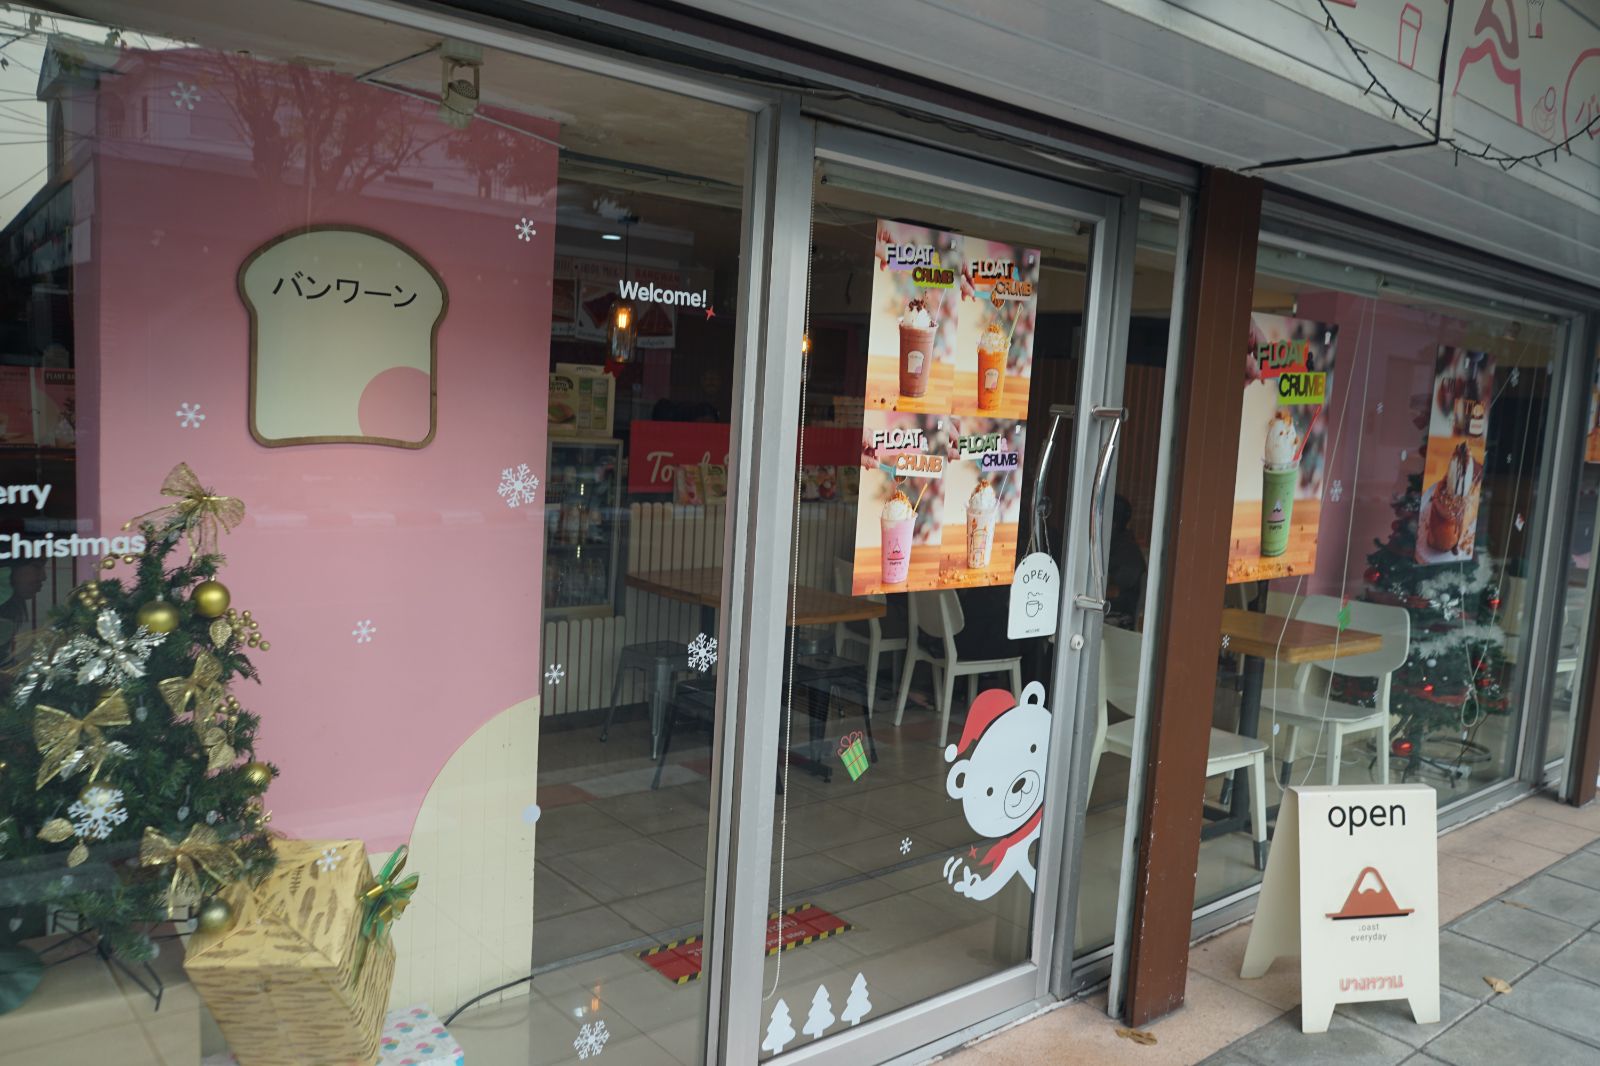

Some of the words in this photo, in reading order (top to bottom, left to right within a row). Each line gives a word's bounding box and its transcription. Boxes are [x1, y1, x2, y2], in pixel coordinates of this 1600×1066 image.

[885, 242, 934, 265] FLOAT
[912, 267, 954, 284] CRUMB
[969, 258, 1014, 279] FLOAT
[272, 270, 418, 309] バンワーン
[619, 279, 708, 308] Welcome!
[995, 281, 1033, 297] CRUMB
[1257, 339, 1307, 370] FLOAT
[1279, 373, 1324, 397] CRUMB
[873, 428, 923, 450] FLOAT
[957, 432, 1001, 455] FLOAT
[896, 452, 942, 472] CRUMB
[982, 453, 1018, 467] CRUMB
[1023, 569, 1050, 584] OPEN
[1328, 803, 1406, 835] open
[1350, 932, 1387, 943] everyday
[1358, 923, 1379, 932] oast
